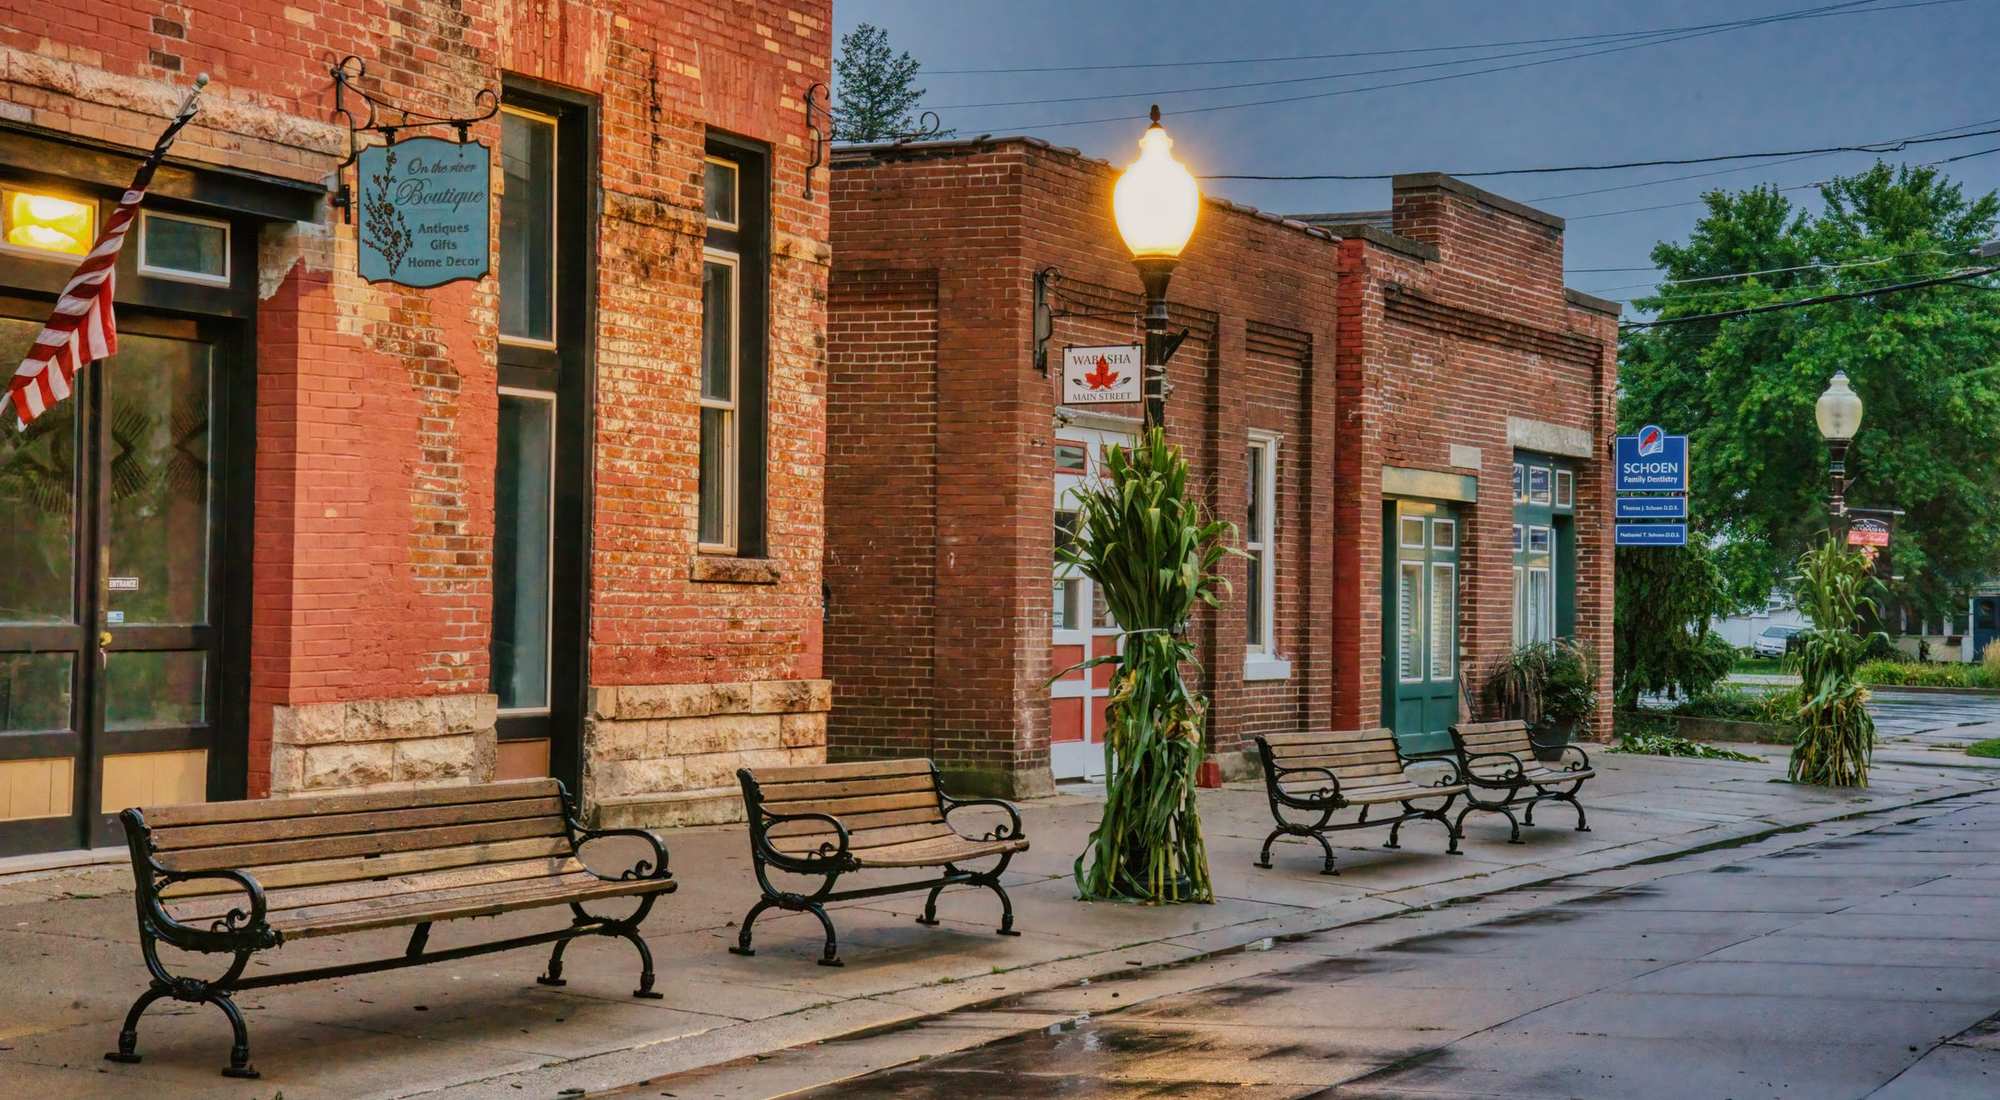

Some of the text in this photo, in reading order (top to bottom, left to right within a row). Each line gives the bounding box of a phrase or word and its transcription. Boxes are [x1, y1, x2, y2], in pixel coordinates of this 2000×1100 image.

[407, 158, 476, 175] On the river
[395, 178, 484, 213] Boutique
[418, 223, 470, 236] Antiques
[430, 239, 458, 250] Gifts
[408, 256, 480, 268] Home Decor
[1072, 354, 1131, 365] WABASHA
[1098, 391, 1132, 400] STREET
[1623, 462, 1678, 474] SCHOEN
[1624, 475, 1678, 484] Family Dentistry
